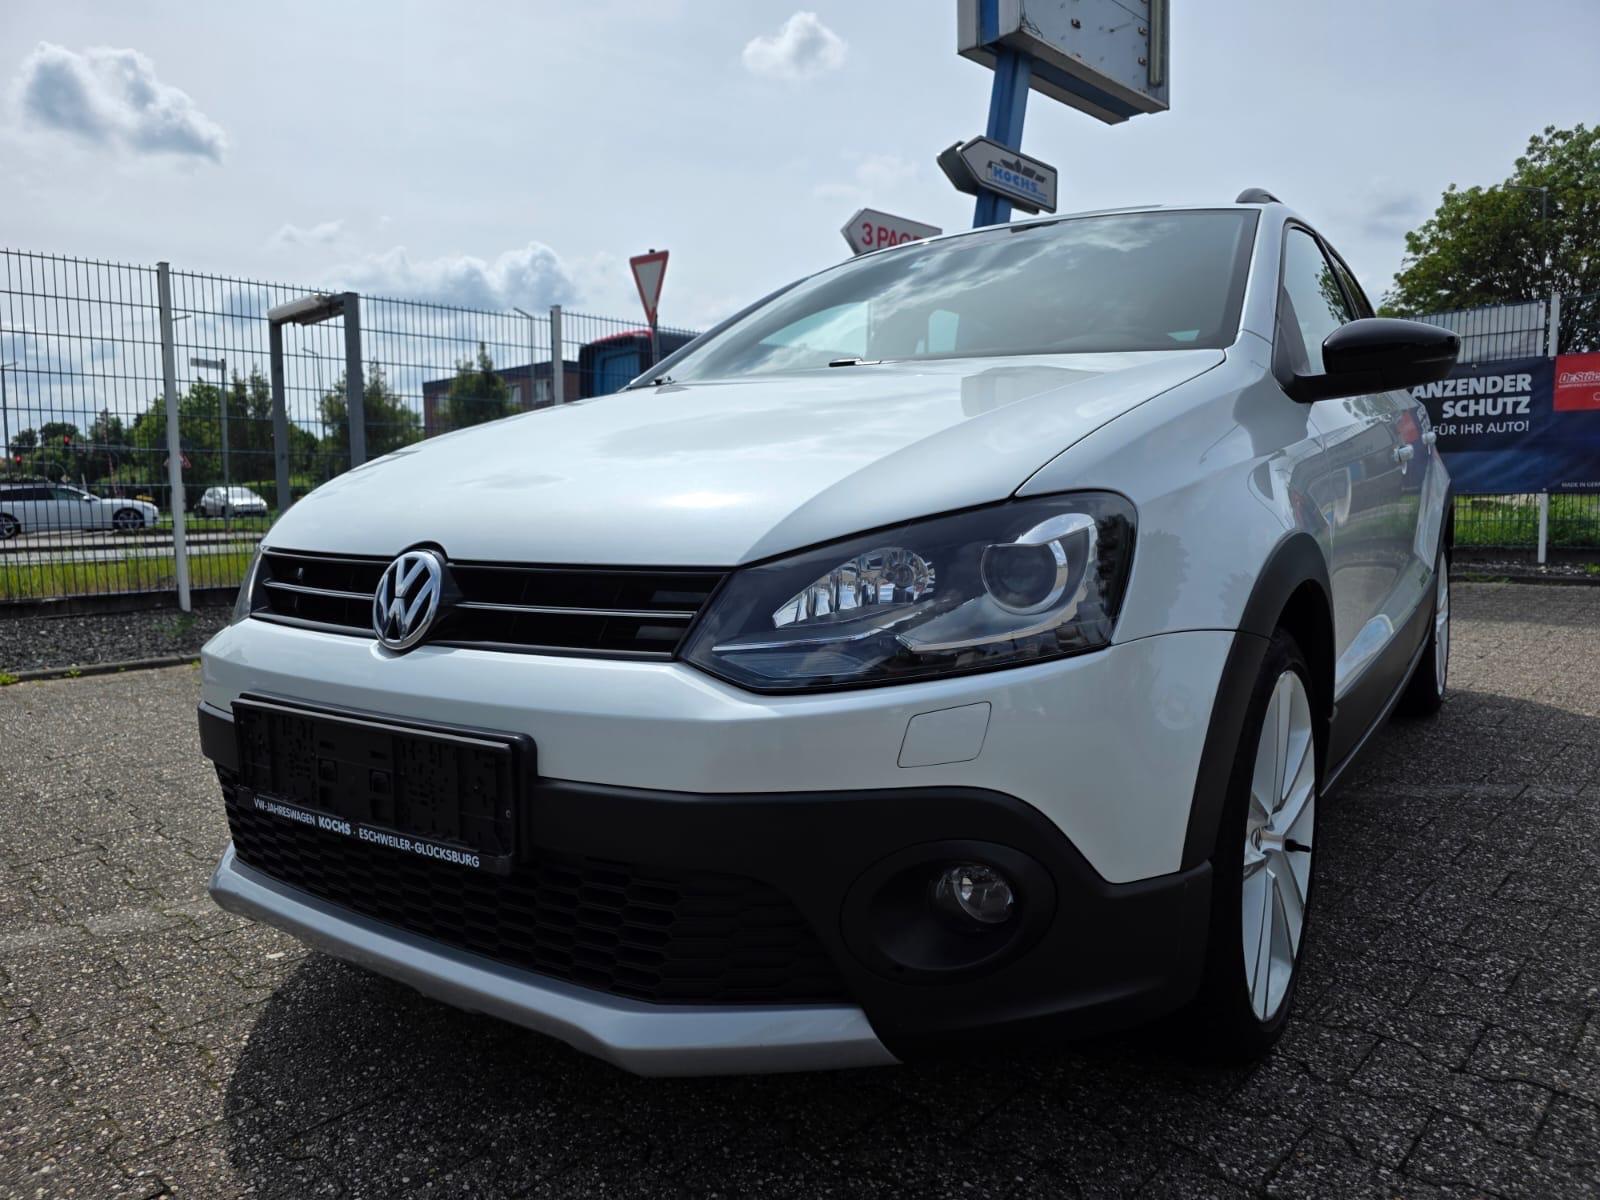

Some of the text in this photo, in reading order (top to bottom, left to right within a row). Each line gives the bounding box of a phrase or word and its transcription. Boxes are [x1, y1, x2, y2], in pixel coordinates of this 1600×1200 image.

[862, 222, 873, 246] 3
[1442, 396, 1530, 419] SCHUTZ
[1432, 420, 1529, 436] FÜR IHR AUTO!
[254, 798, 480, 868] VW-JAHRESWAGEN KOCHS ESCHWEILER-GLÜCKSBURG
